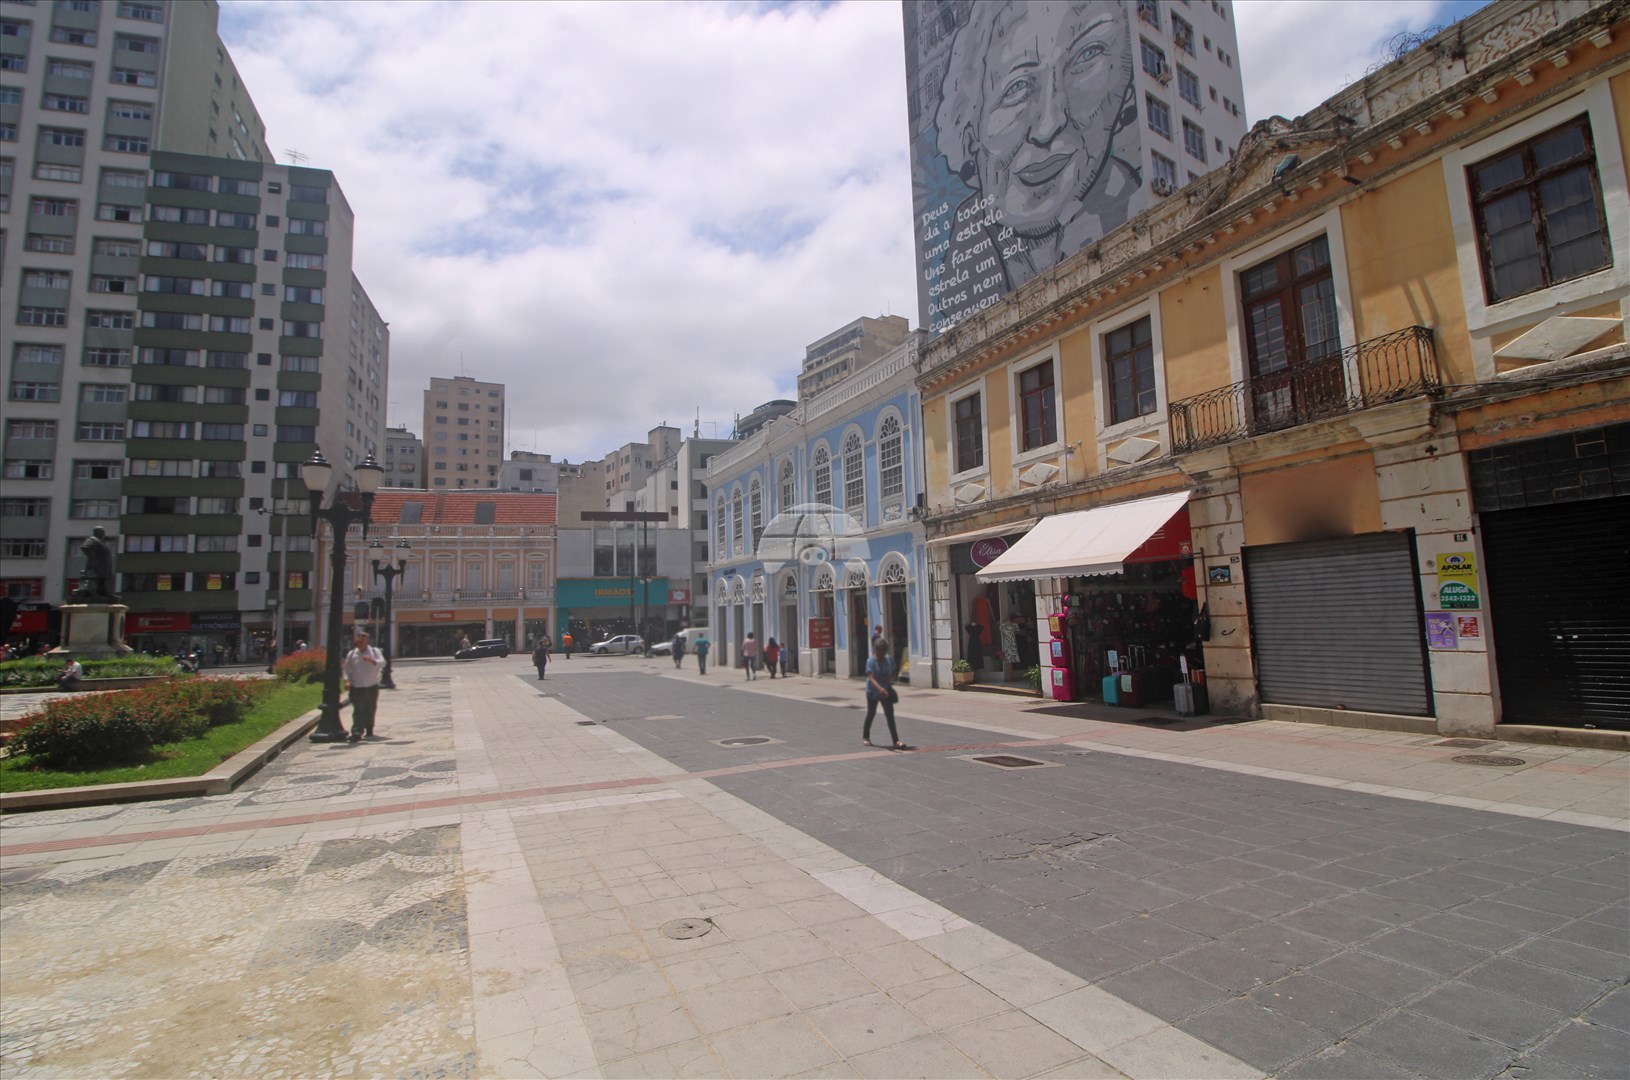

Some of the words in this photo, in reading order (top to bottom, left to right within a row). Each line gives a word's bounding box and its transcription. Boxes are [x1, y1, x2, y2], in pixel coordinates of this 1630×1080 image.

[922, 202, 949, 227] Deus
[924, 223, 940, 241] dá
[944, 220, 951, 230] a
[957, 194, 995, 222] todos
[925, 239, 950, 260] uma
[925, 263, 946, 281] Uns
[951, 237, 993, 269] fazem
[997, 226, 1014, 242] da
[928, 269, 970, 297] estrela
[976, 256, 996, 273] um
[1003, 237, 1029, 260] sol.
[928, 290, 968, 316] Outros
[973, 272, 1003, 296] nem
[1441, 563, 1472, 571] APOLAR
[1443, 586, 1469, 594] ALUGA
